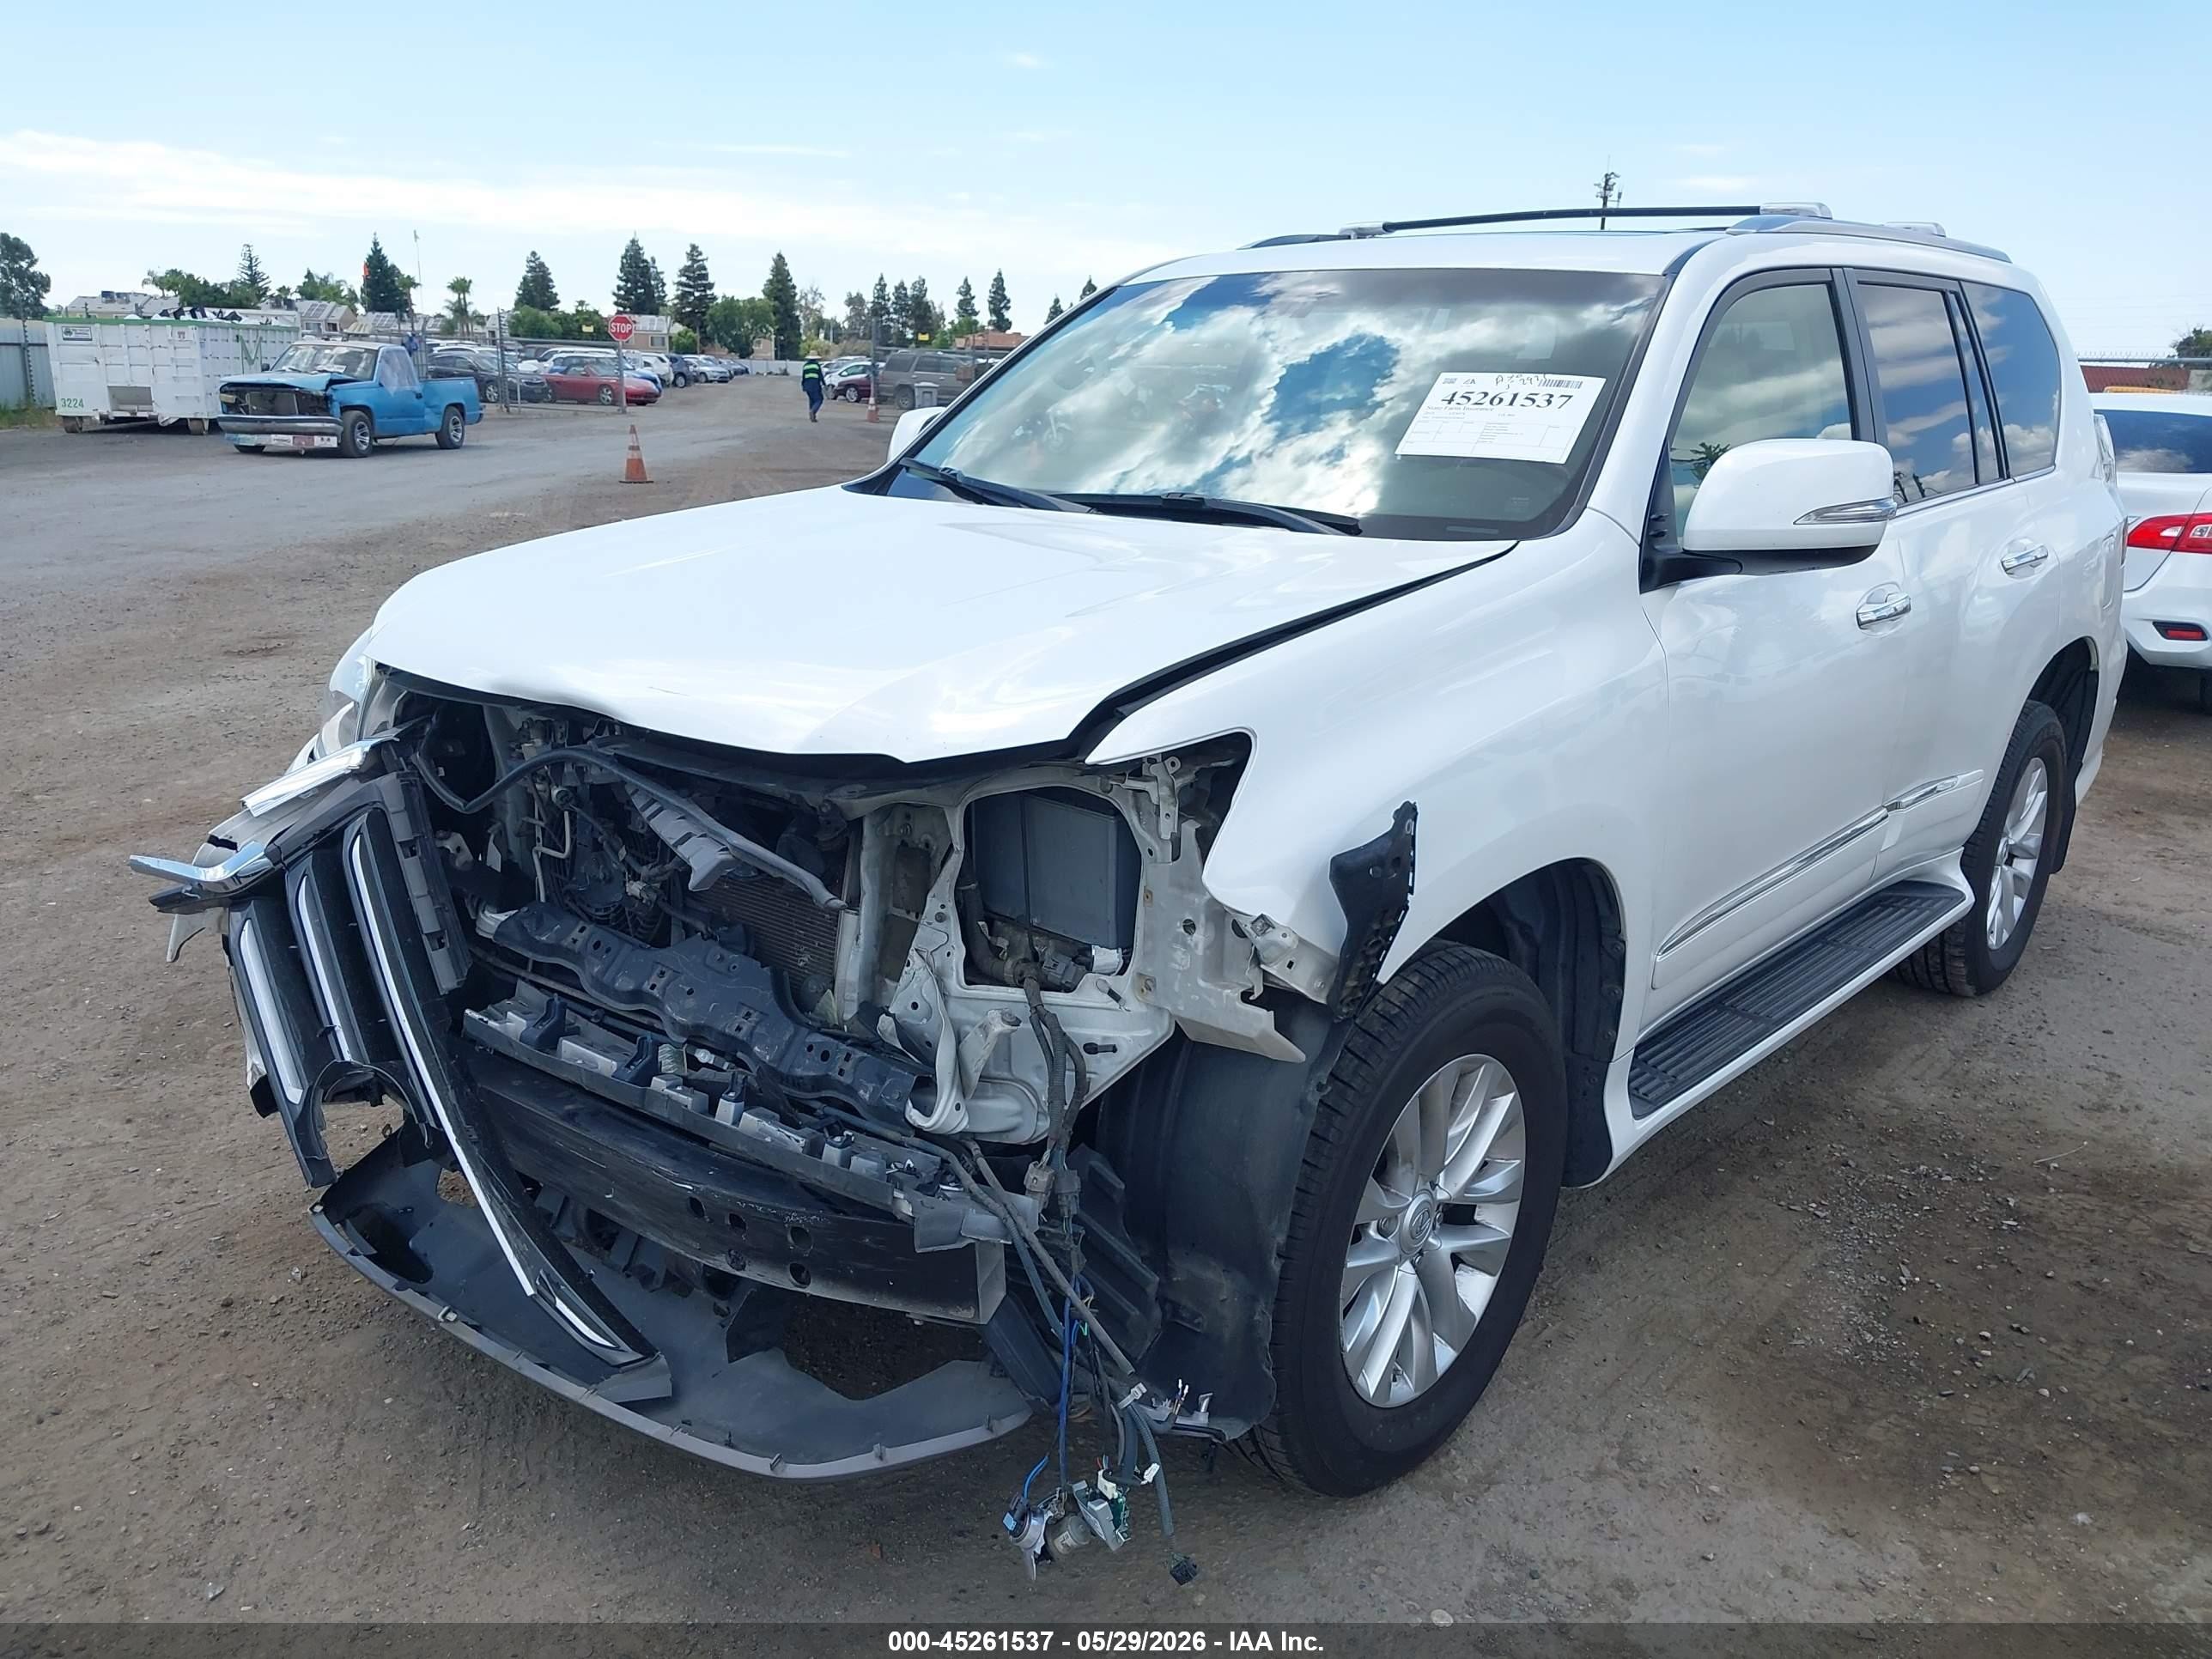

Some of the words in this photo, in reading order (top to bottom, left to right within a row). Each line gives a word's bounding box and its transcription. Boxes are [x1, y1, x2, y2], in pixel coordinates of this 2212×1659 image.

[611, 322, 632, 333] STOP
[61, 398, 84, 409] 3224
[1441, 391, 1574, 410] 45261537
